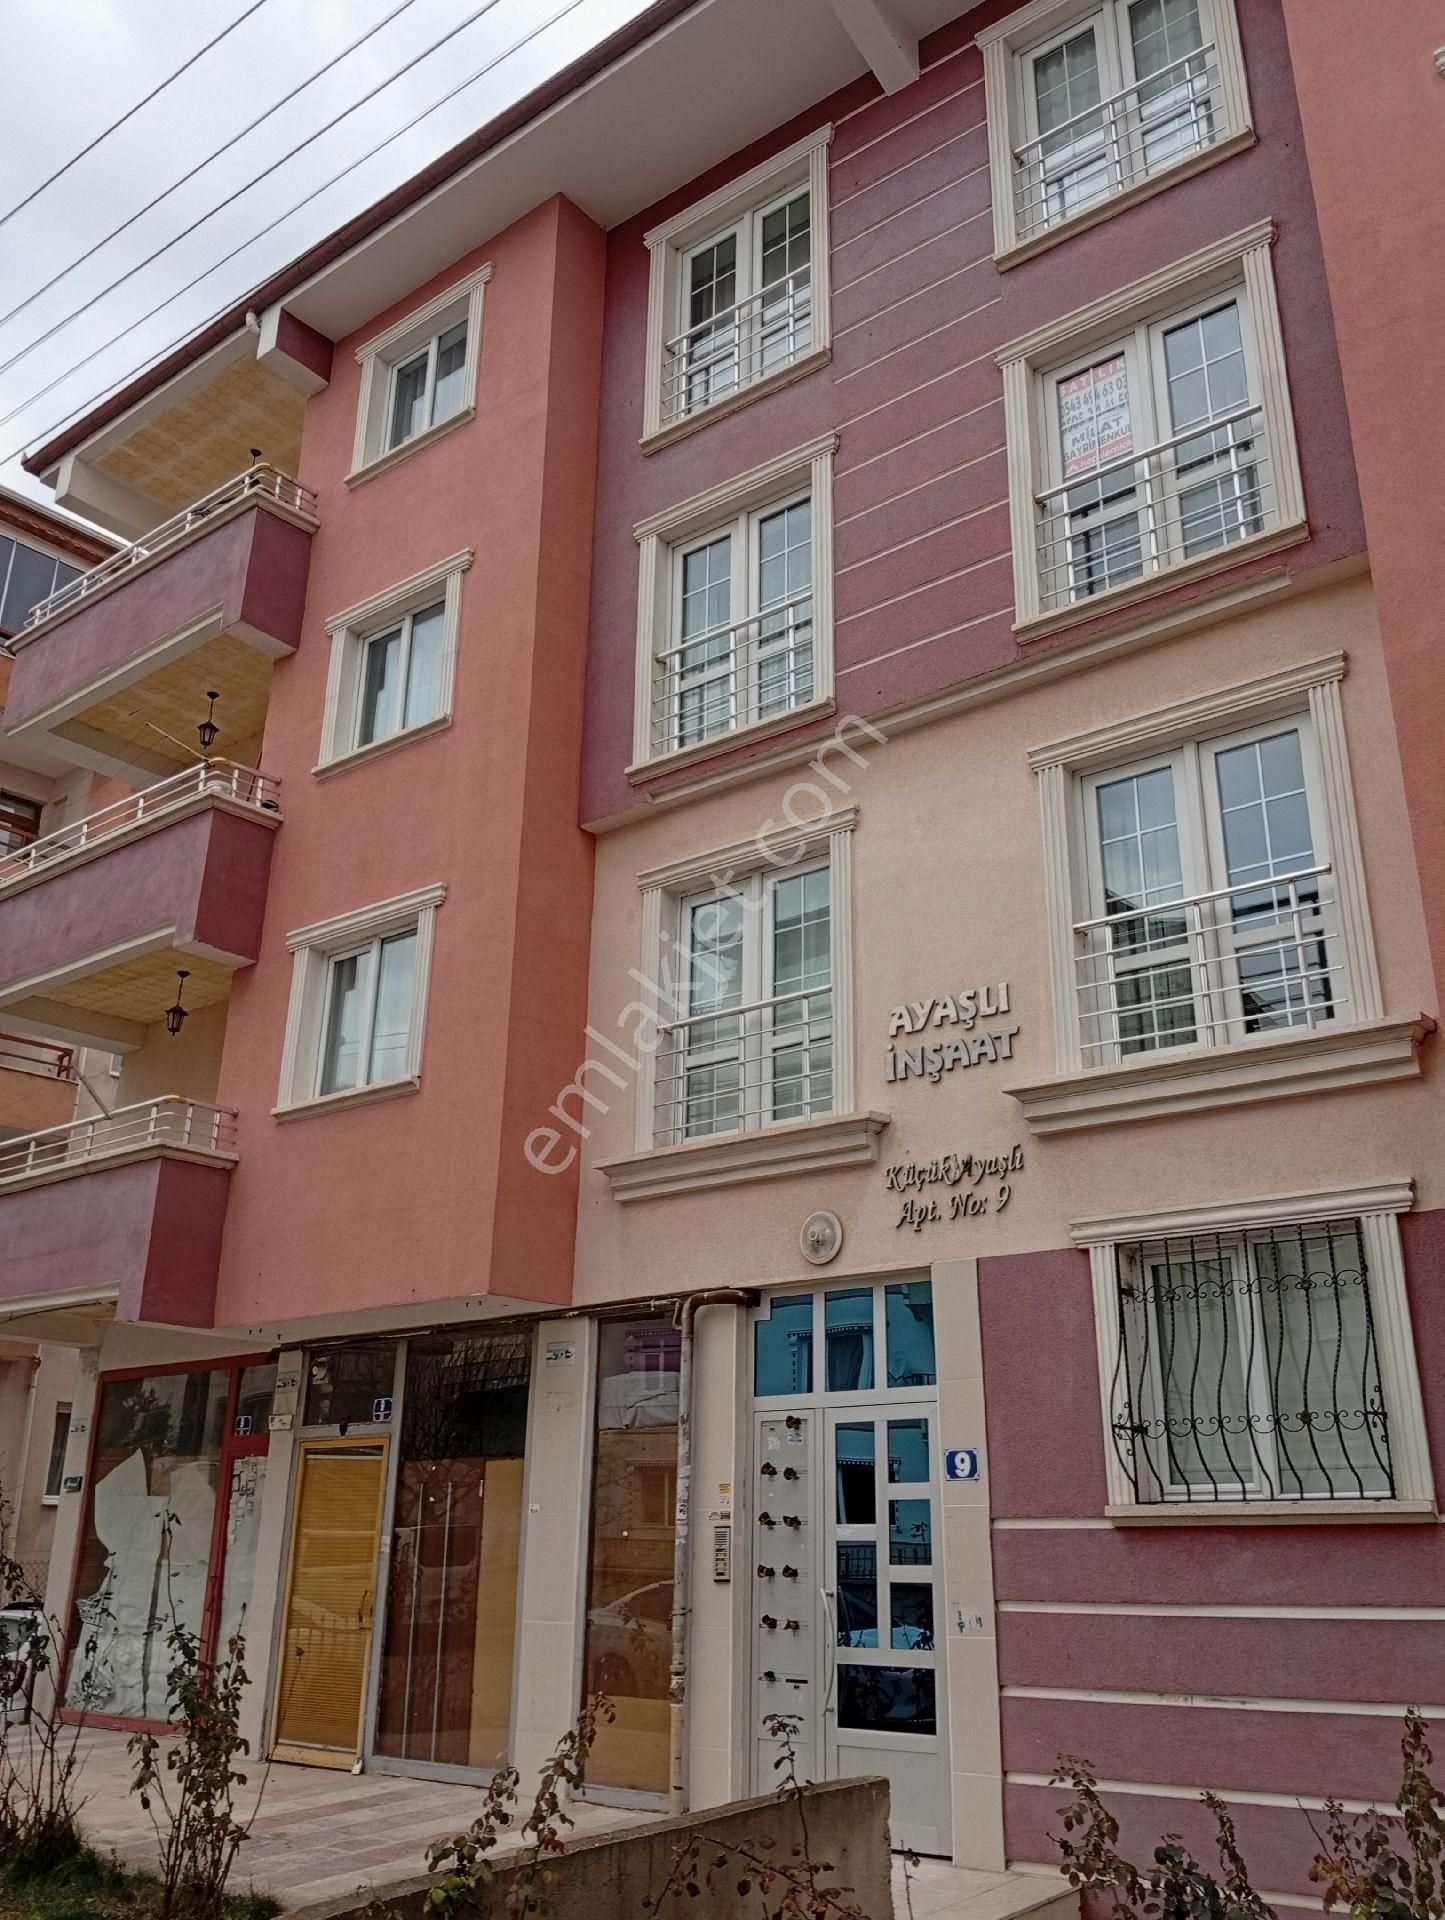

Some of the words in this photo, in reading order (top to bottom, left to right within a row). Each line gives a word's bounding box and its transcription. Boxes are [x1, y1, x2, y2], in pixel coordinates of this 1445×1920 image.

[1060, 356, 1126, 396] SATLIK
[1102, 381, 1114, 397] 63
[888, 982, 1010, 1037] AYAŞLI
[886, 1024, 1020, 1083] İNŞAAT
[886, 1155, 956, 1192] Küçük
[951, 1144, 1024, 1186] Ayaşlı
[896, 1199, 942, 1232] Apt.
[950, 1192, 988, 1219] No:
[996, 1185, 1011, 1213] 9
[954, 1451, 971, 1478] 9
